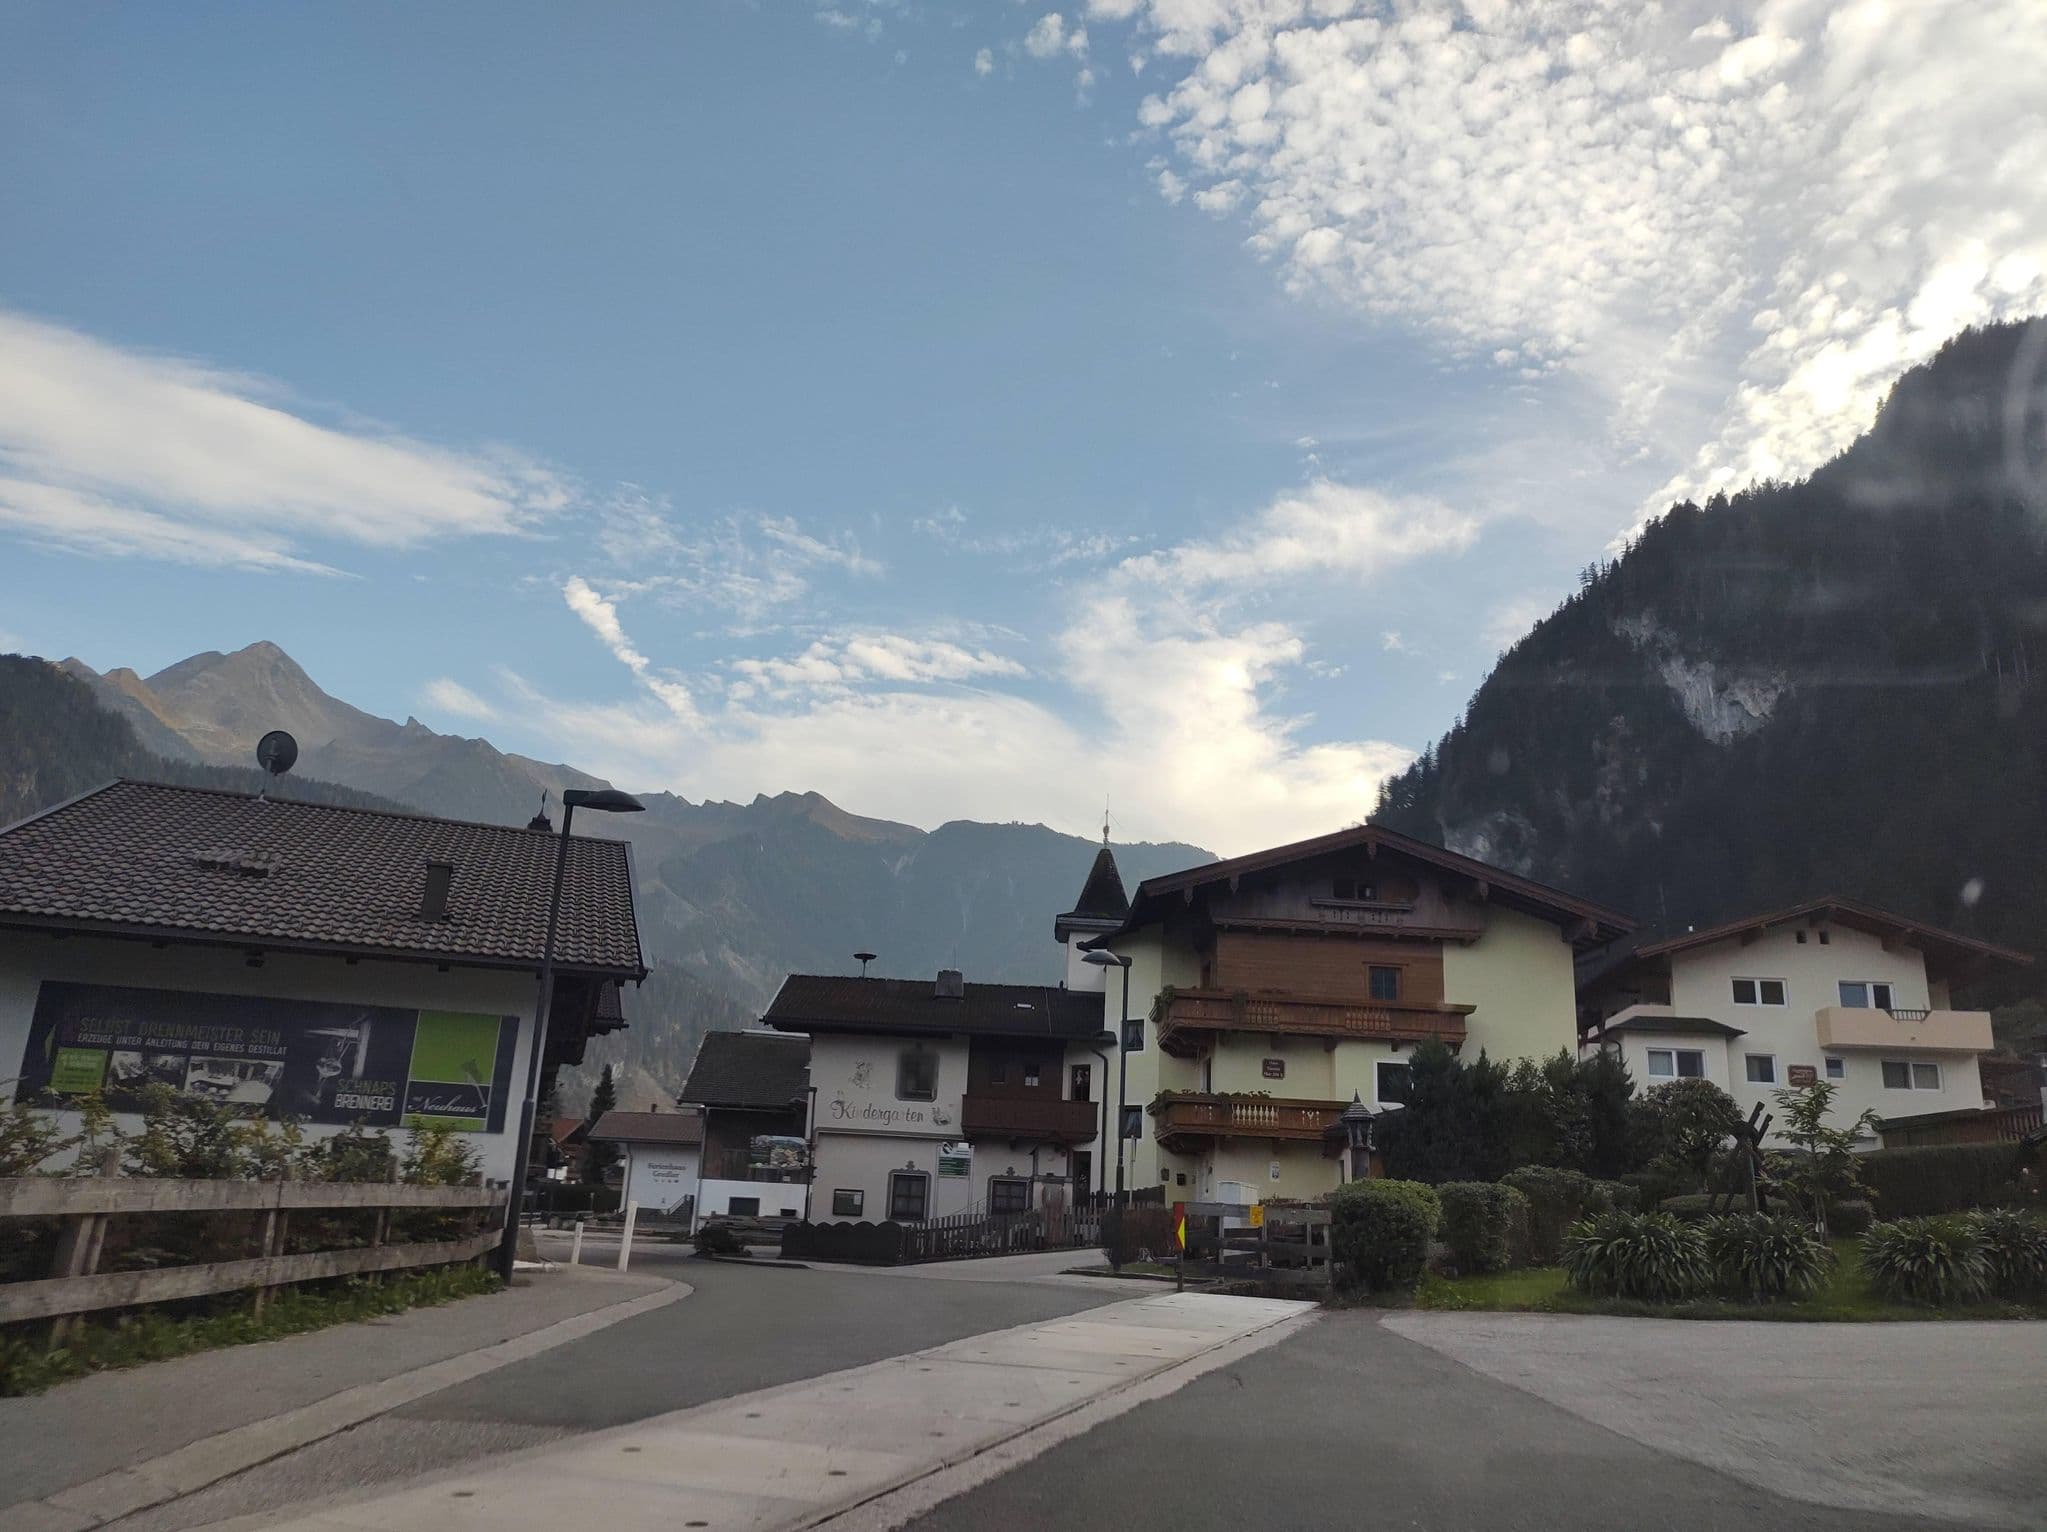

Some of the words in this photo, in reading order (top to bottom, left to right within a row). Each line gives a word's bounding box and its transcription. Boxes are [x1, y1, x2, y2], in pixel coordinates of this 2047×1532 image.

[77, 1033, 113, 1045] ERZEUGE
[116, 1036, 143, 1046] UNTER
[145, 1038, 188, 1049] ANLEITUNG
[248, 1045, 288, 1056] DESTILLAT
[251, 1029, 281, 1045] SEIN
[337, 1078, 396, 1096] SCHNAPS
[334, 1093, 395, 1112] BRENNEREI
